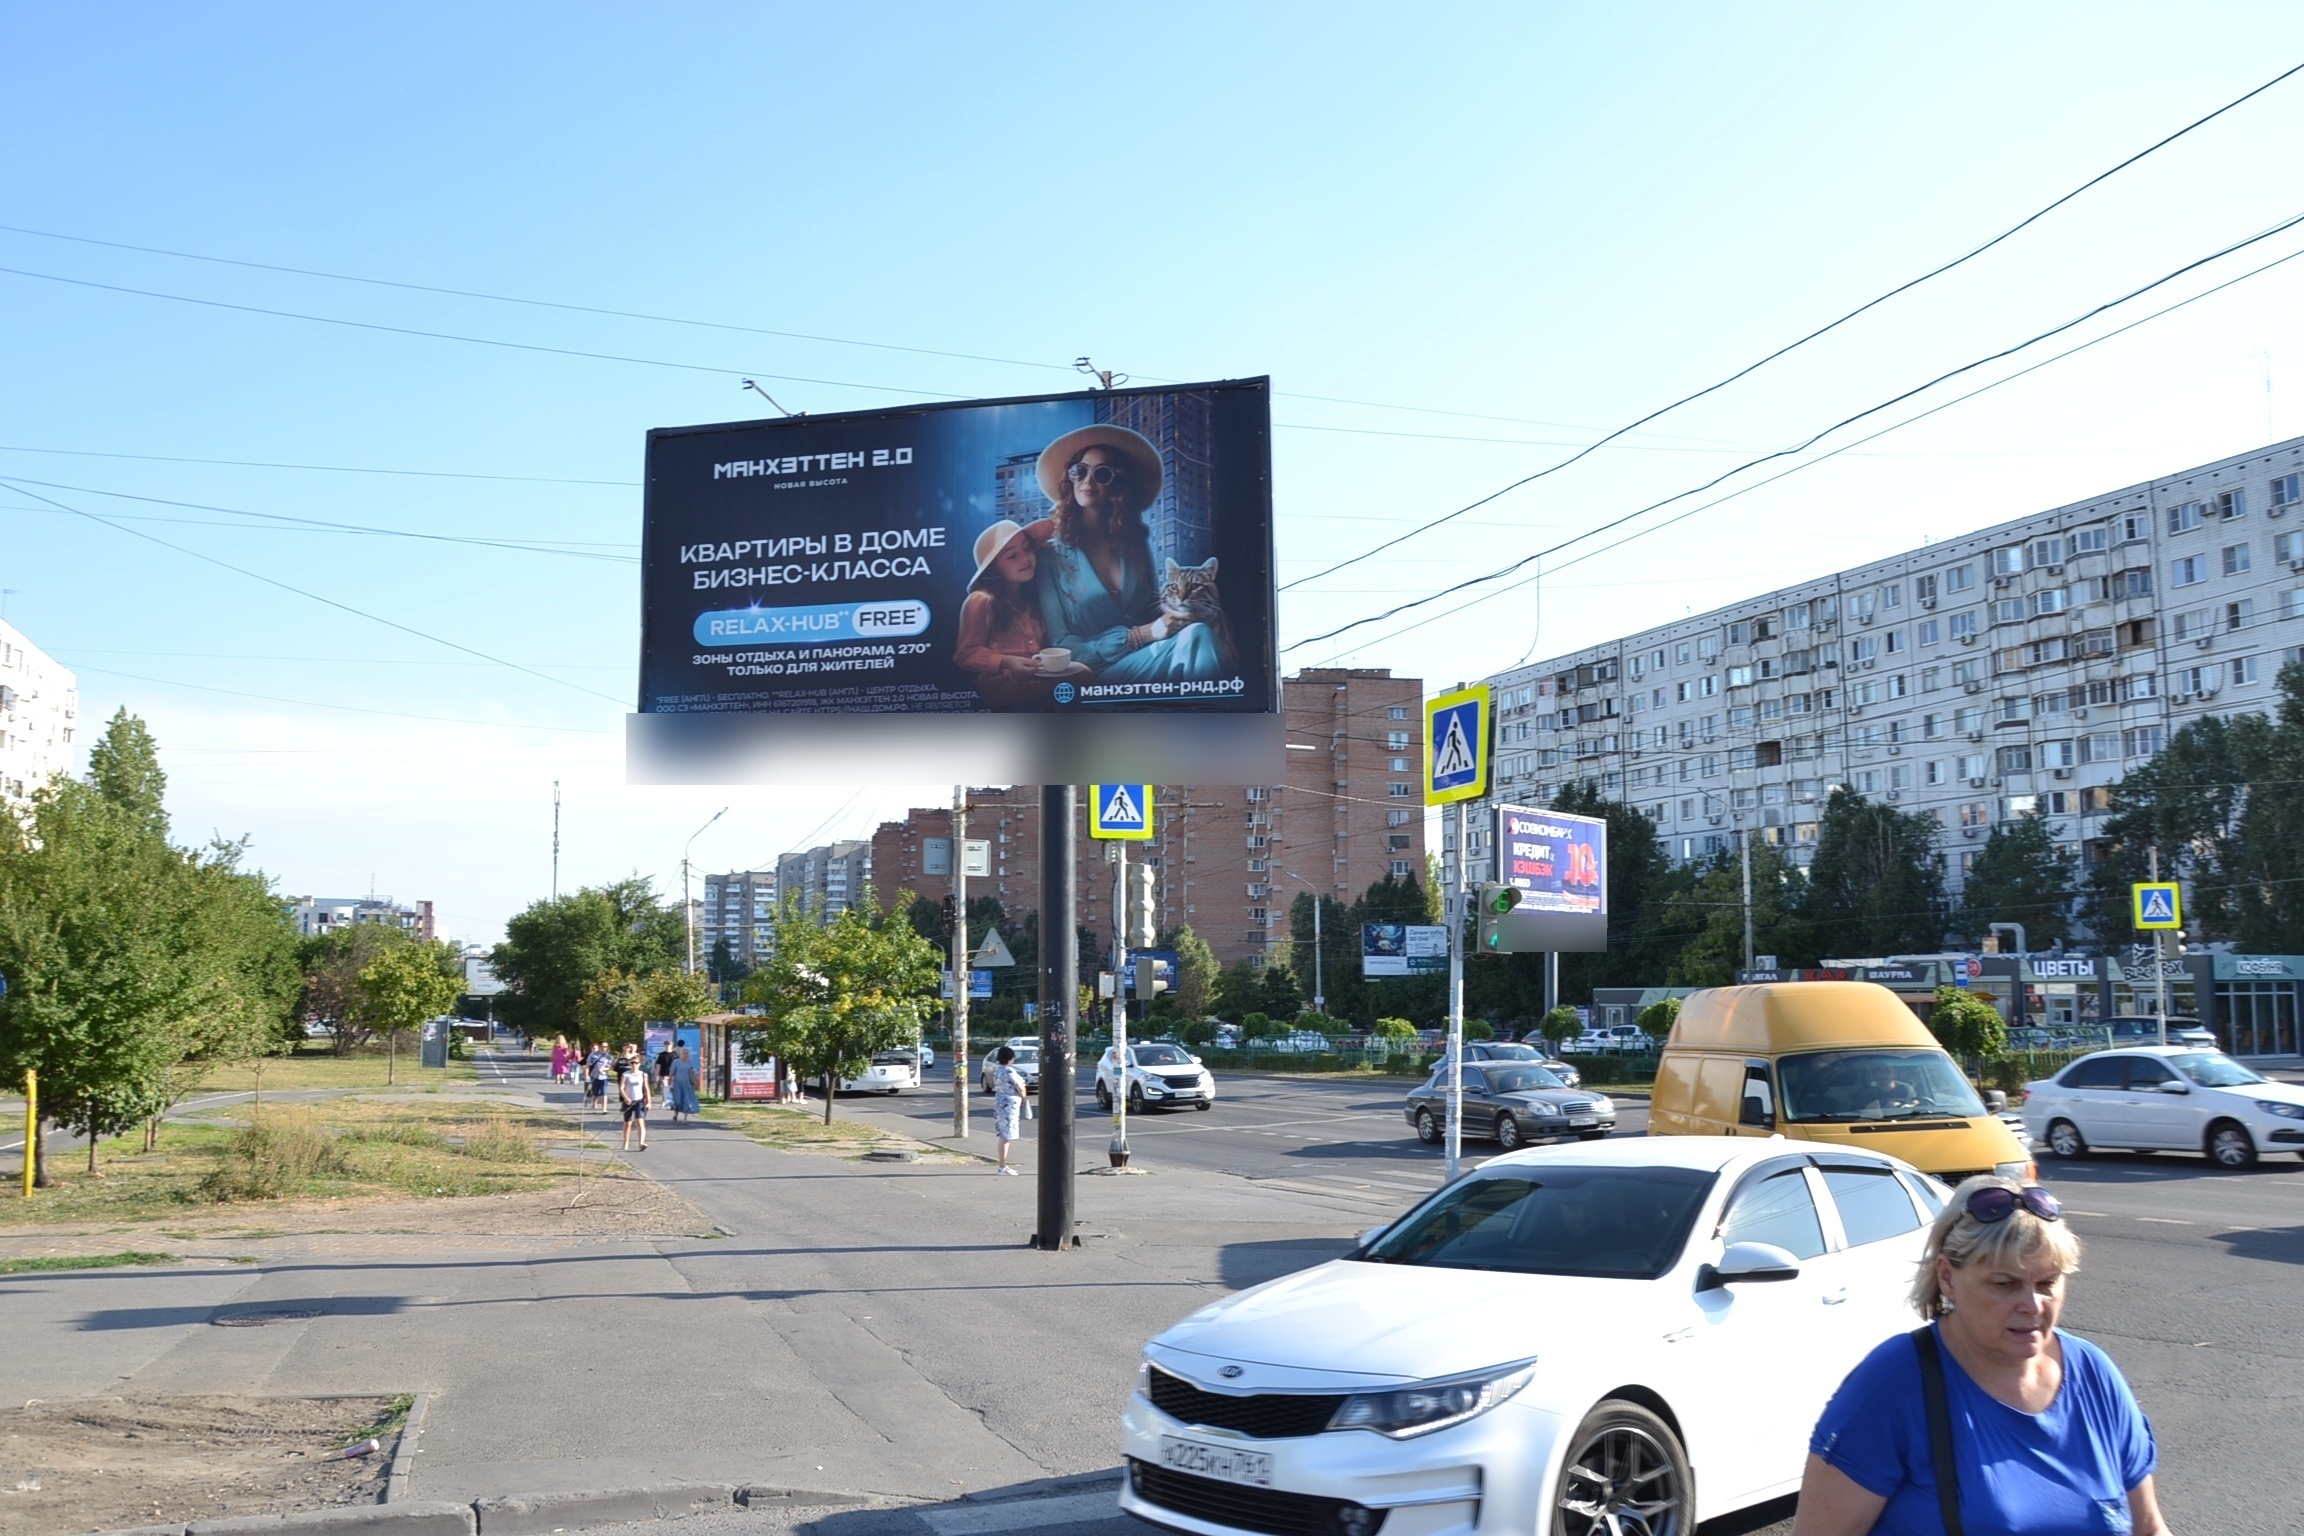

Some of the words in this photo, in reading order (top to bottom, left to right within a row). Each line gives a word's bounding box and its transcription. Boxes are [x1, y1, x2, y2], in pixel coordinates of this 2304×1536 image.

[714, 451, 864, 479] МАНХЭТТЕН
[872, 447, 913, 467] 2.0
[774, 481, 806, 490] НОВАЯ
[809, 477, 848, 487] ВЫСОТА
[680, 535, 827, 563] КВАРТИРЫ
[834, 533, 852, 553] В
[858, 527, 946, 554] ДОМЕ
[693, 556, 931, 589] БИЗНЕС-КЛАССА
[692, 653, 733, 665] ЗОНЫ
[735, 650, 796, 663] ОТДЫХА
[799, 649, 810, 660] И
[812, 645, 895, 659] ПАНОРАМА
[898, 642, 931, 655] 270°
[726, 663, 784, 676] ТОЛЬКО
[785, 661, 818, 675] ДЛЯ
[820, 656, 894, 672] ЖИТЕЛЕЙ
[866, 685, 896, 695] ЦЕНТР
[1080, 676, 1245, 696] манхэттен-рнд.рф
[752, 700, 772, 708] ИНН
[820, 697, 835, 706] ЖК
[836, 695, 891, 704] МАНХЭТТЕН
[906, 693, 939, 702] НОВАЯ
[1513, 842, 1551, 860] КРЕДИТ
[1513, 860, 1554, 877] КЭШБЭК
[1868, 970, 1913, 979] ШАУРМА
[2033, 960, 2094, 978] ЦВЕТЫ
